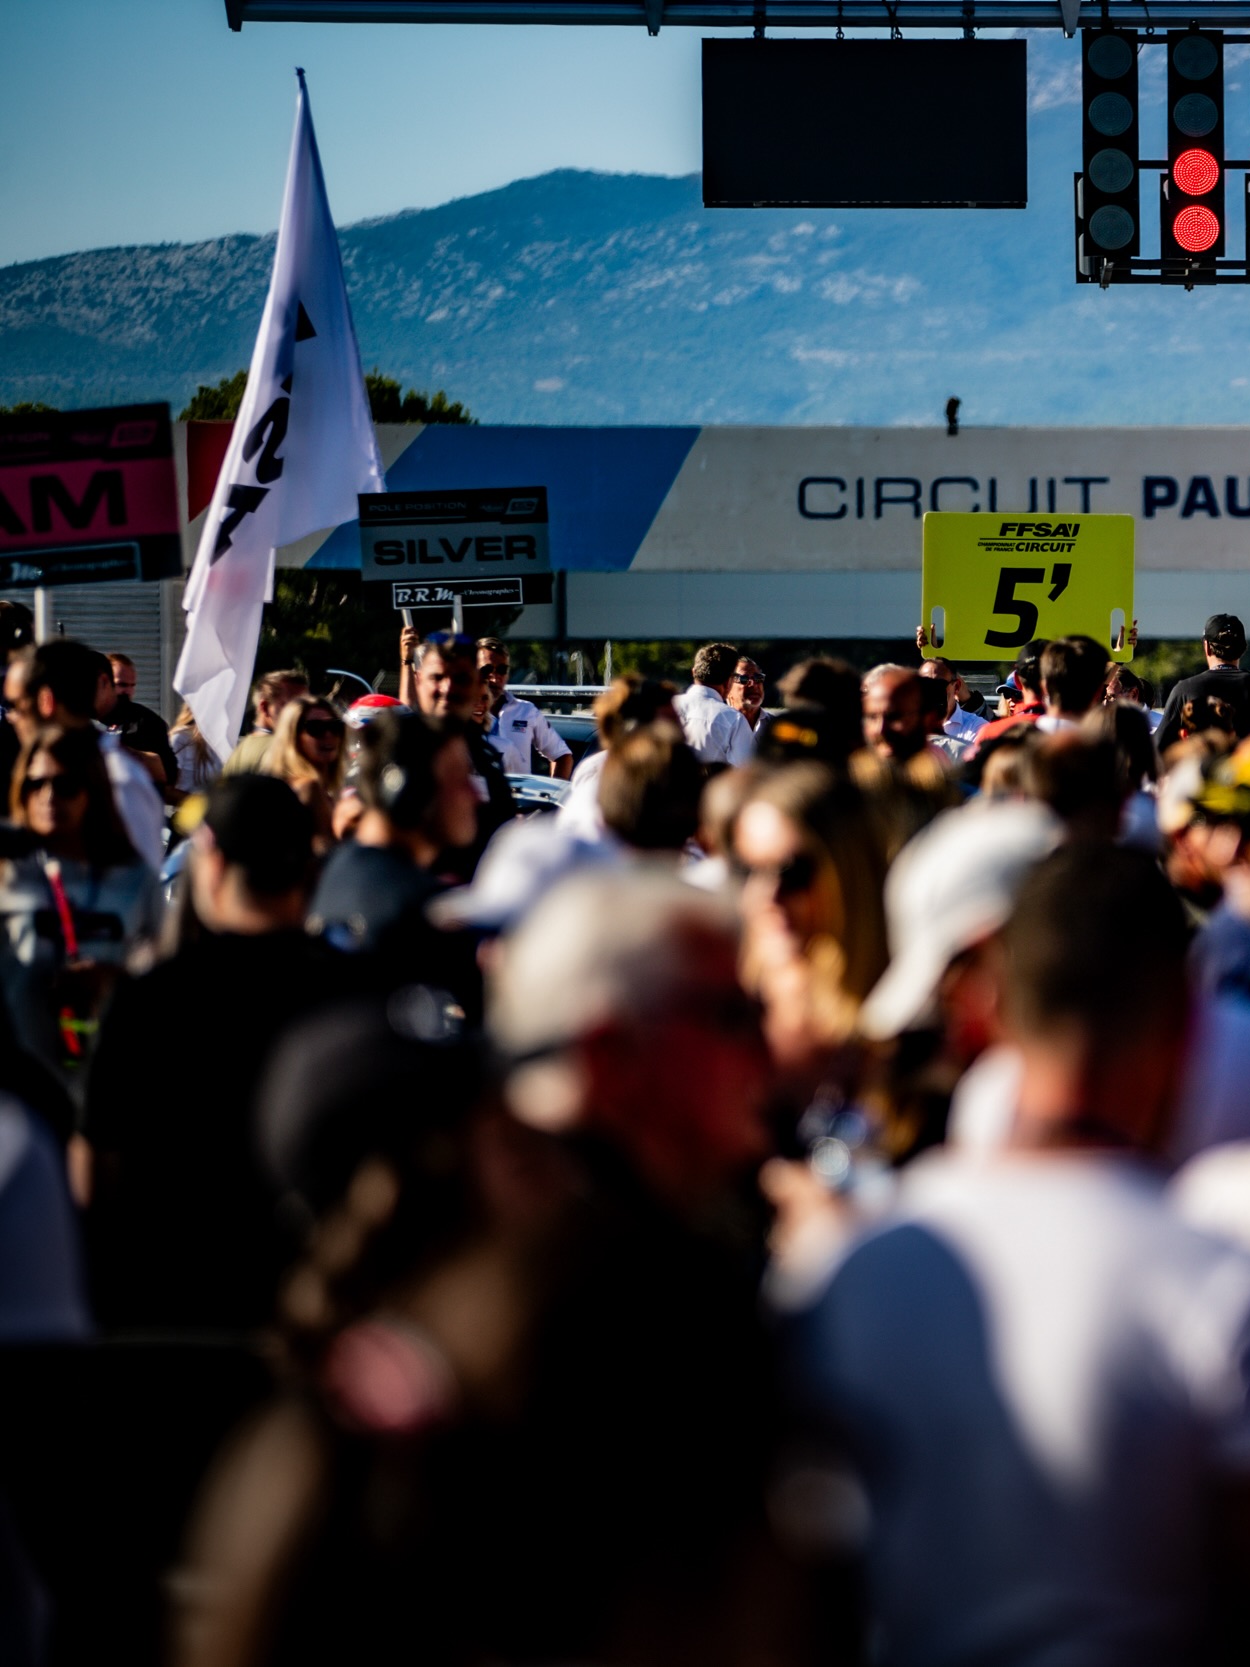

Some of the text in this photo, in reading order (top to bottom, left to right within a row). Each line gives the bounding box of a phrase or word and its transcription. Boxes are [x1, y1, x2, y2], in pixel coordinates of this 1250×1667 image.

[368, 503, 400, 513] POLE
[404, 502, 468, 511] POSITION
[798, 476, 1109, 519] CIRCUIT
[374, 535, 536, 565] SILVER
[1015, 542, 1076, 553] CIRCUIT
